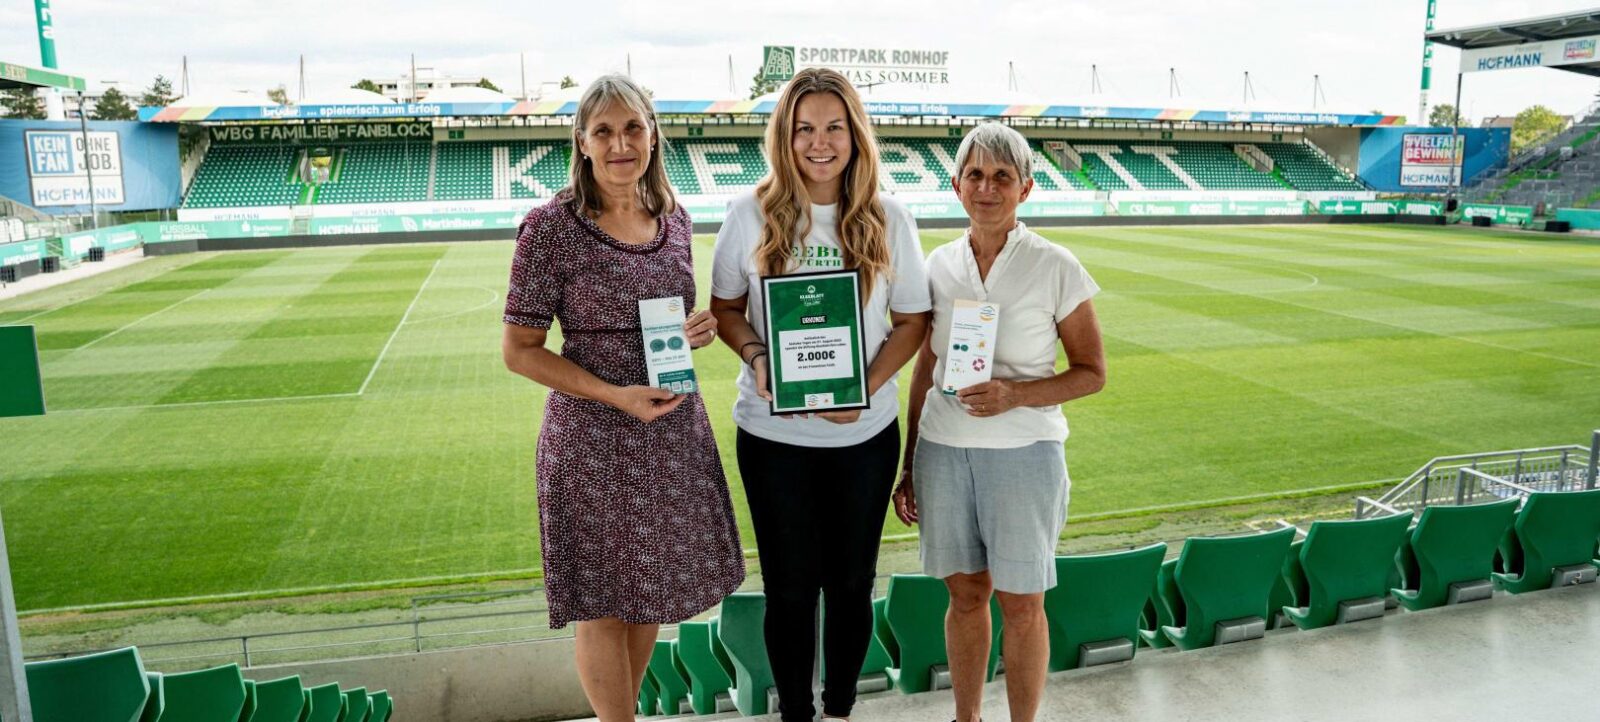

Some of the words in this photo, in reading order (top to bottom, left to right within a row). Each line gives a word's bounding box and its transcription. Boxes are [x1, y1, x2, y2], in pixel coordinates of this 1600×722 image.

[800, 48, 886, 63] SPORTPARK
[892, 50, 949, 67] RONHOF
[1477, 52, 1542, 70] HOFMANN
[879, 70, 949, 84] SOMMER
[320, 106, 379, 117] spielerisch
[382, 107, 405, 115] zum
[408, 105, 441, 116] Erfolg
[212, 127, 255, 141] WBG
[260, 123, 432, 141] FAMILIEN-FANBLOCK
[33, 136, 67, 152] KEIN
[76, 137, 111, 152] OHNE
[36, 153, 70, 172] FAN
[78, 153, 117, 171] JOB.
[38, 188, 117, 201] HOFMANN
[160, 224, 207, 233] FUSSBALL
[423, 219, 484, 230] MartinBauer
[797, 350, 836, 362] 2.000€
